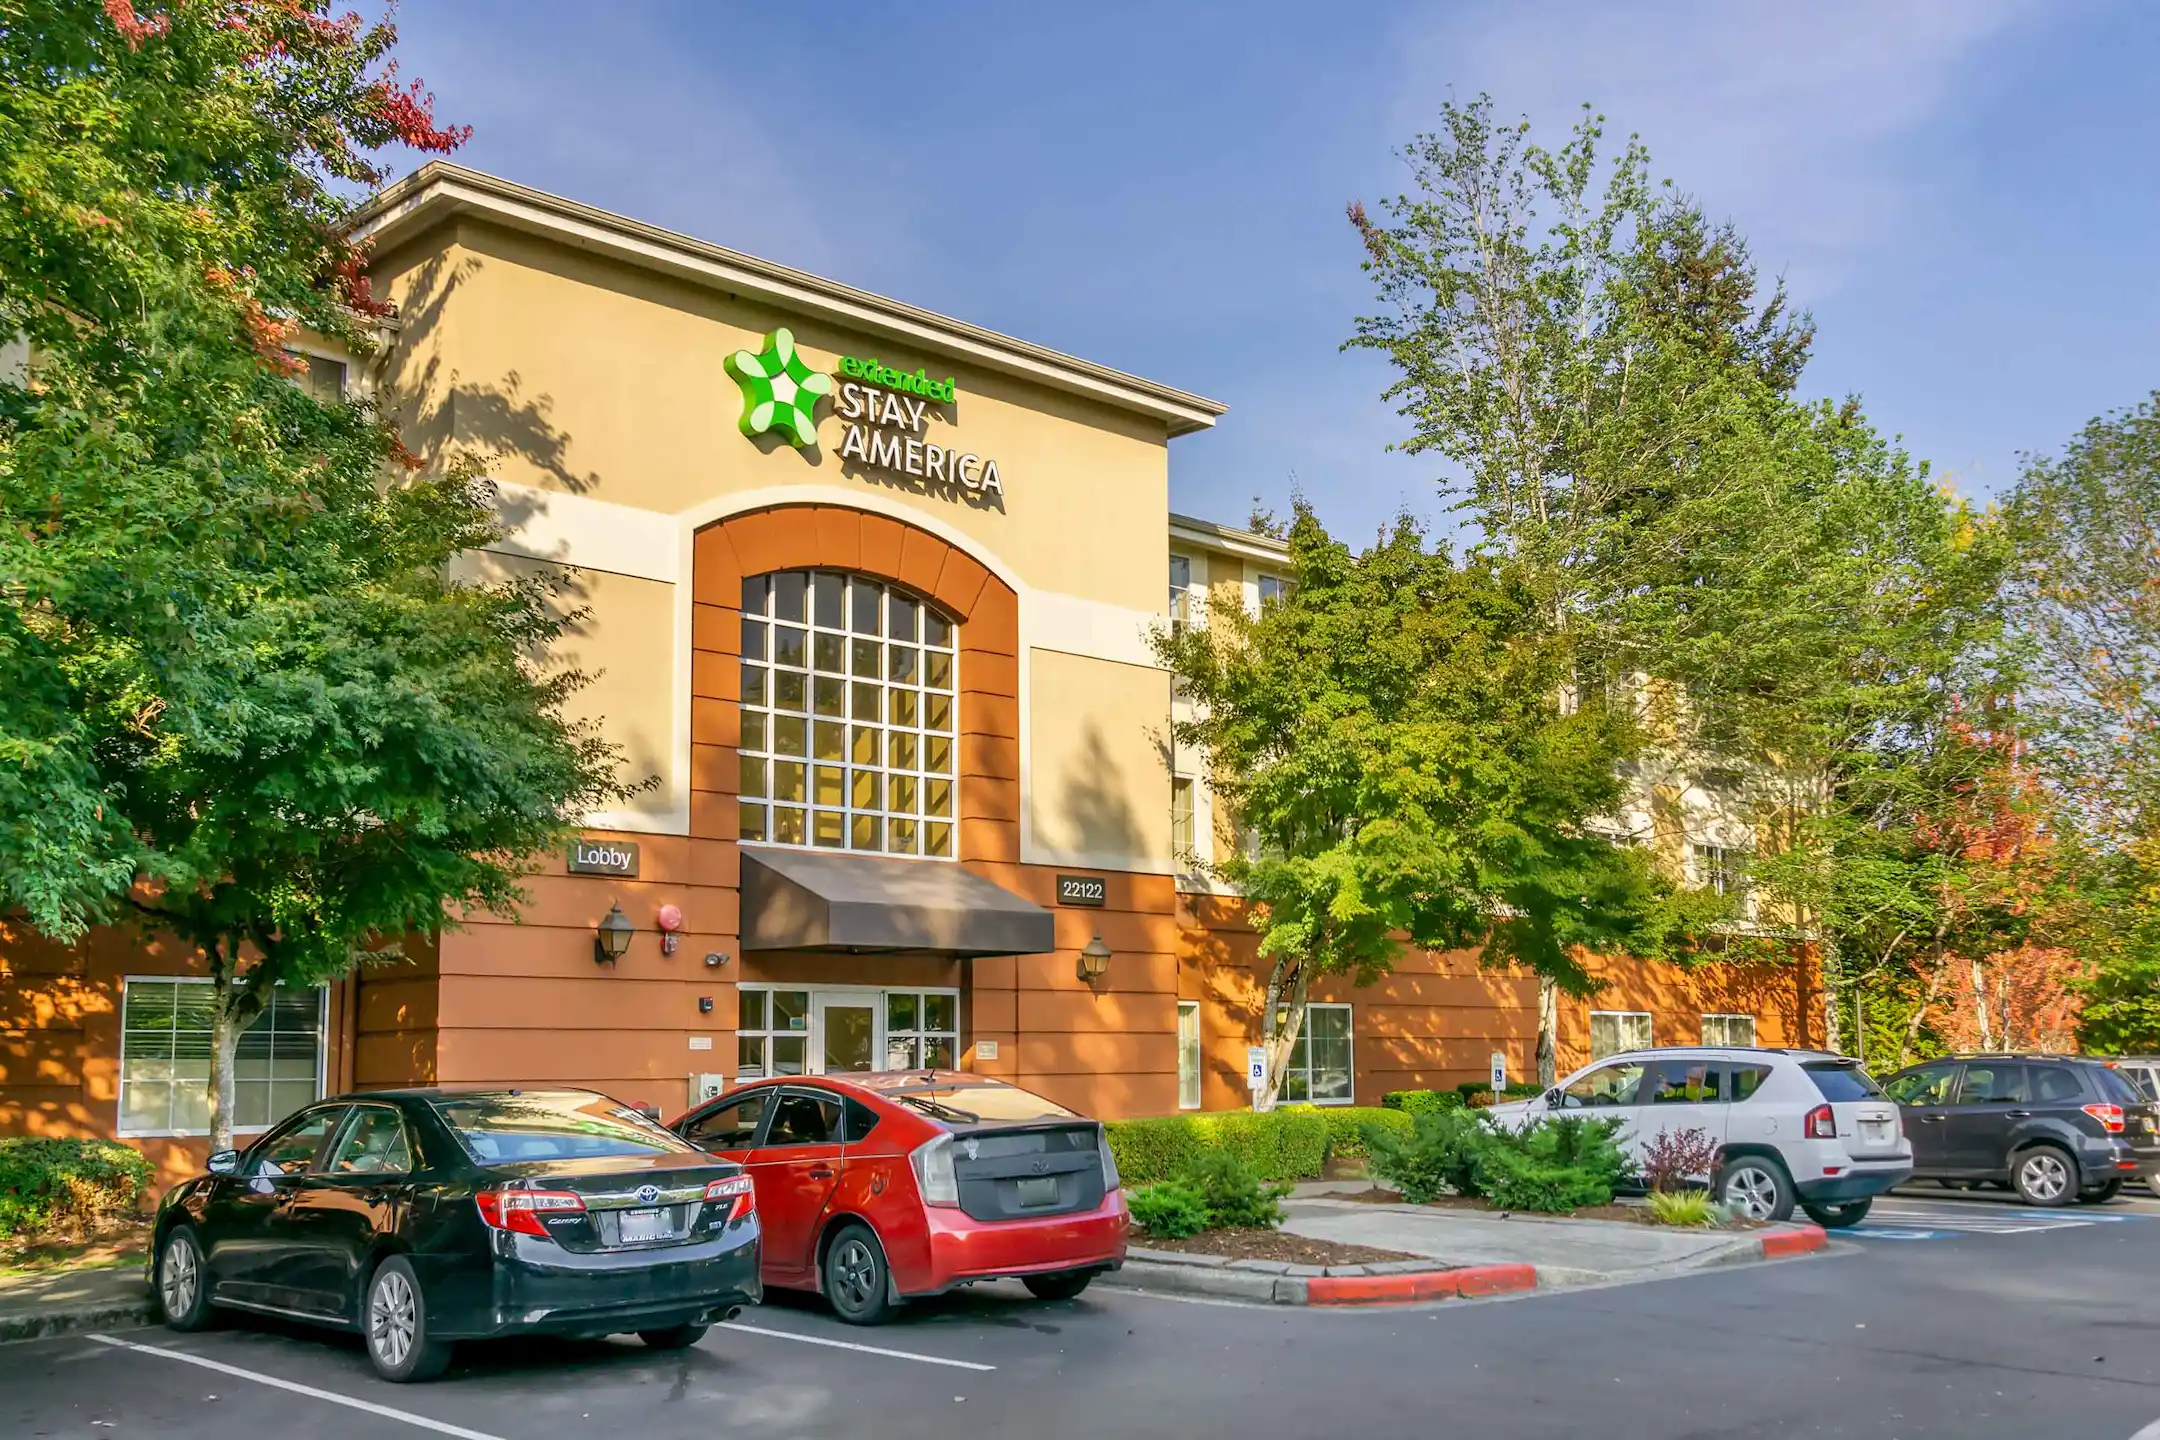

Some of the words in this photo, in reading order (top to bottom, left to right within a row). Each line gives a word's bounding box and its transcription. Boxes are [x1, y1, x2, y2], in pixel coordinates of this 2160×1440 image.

[839, 355, 956, 404] extended
[842, 382, 926, 432] STAY
[842, 425, 1003, 495] AMERICA
[577, 845, 631, 870] Lobby
[1063, 881, 1103, 899] 22122
